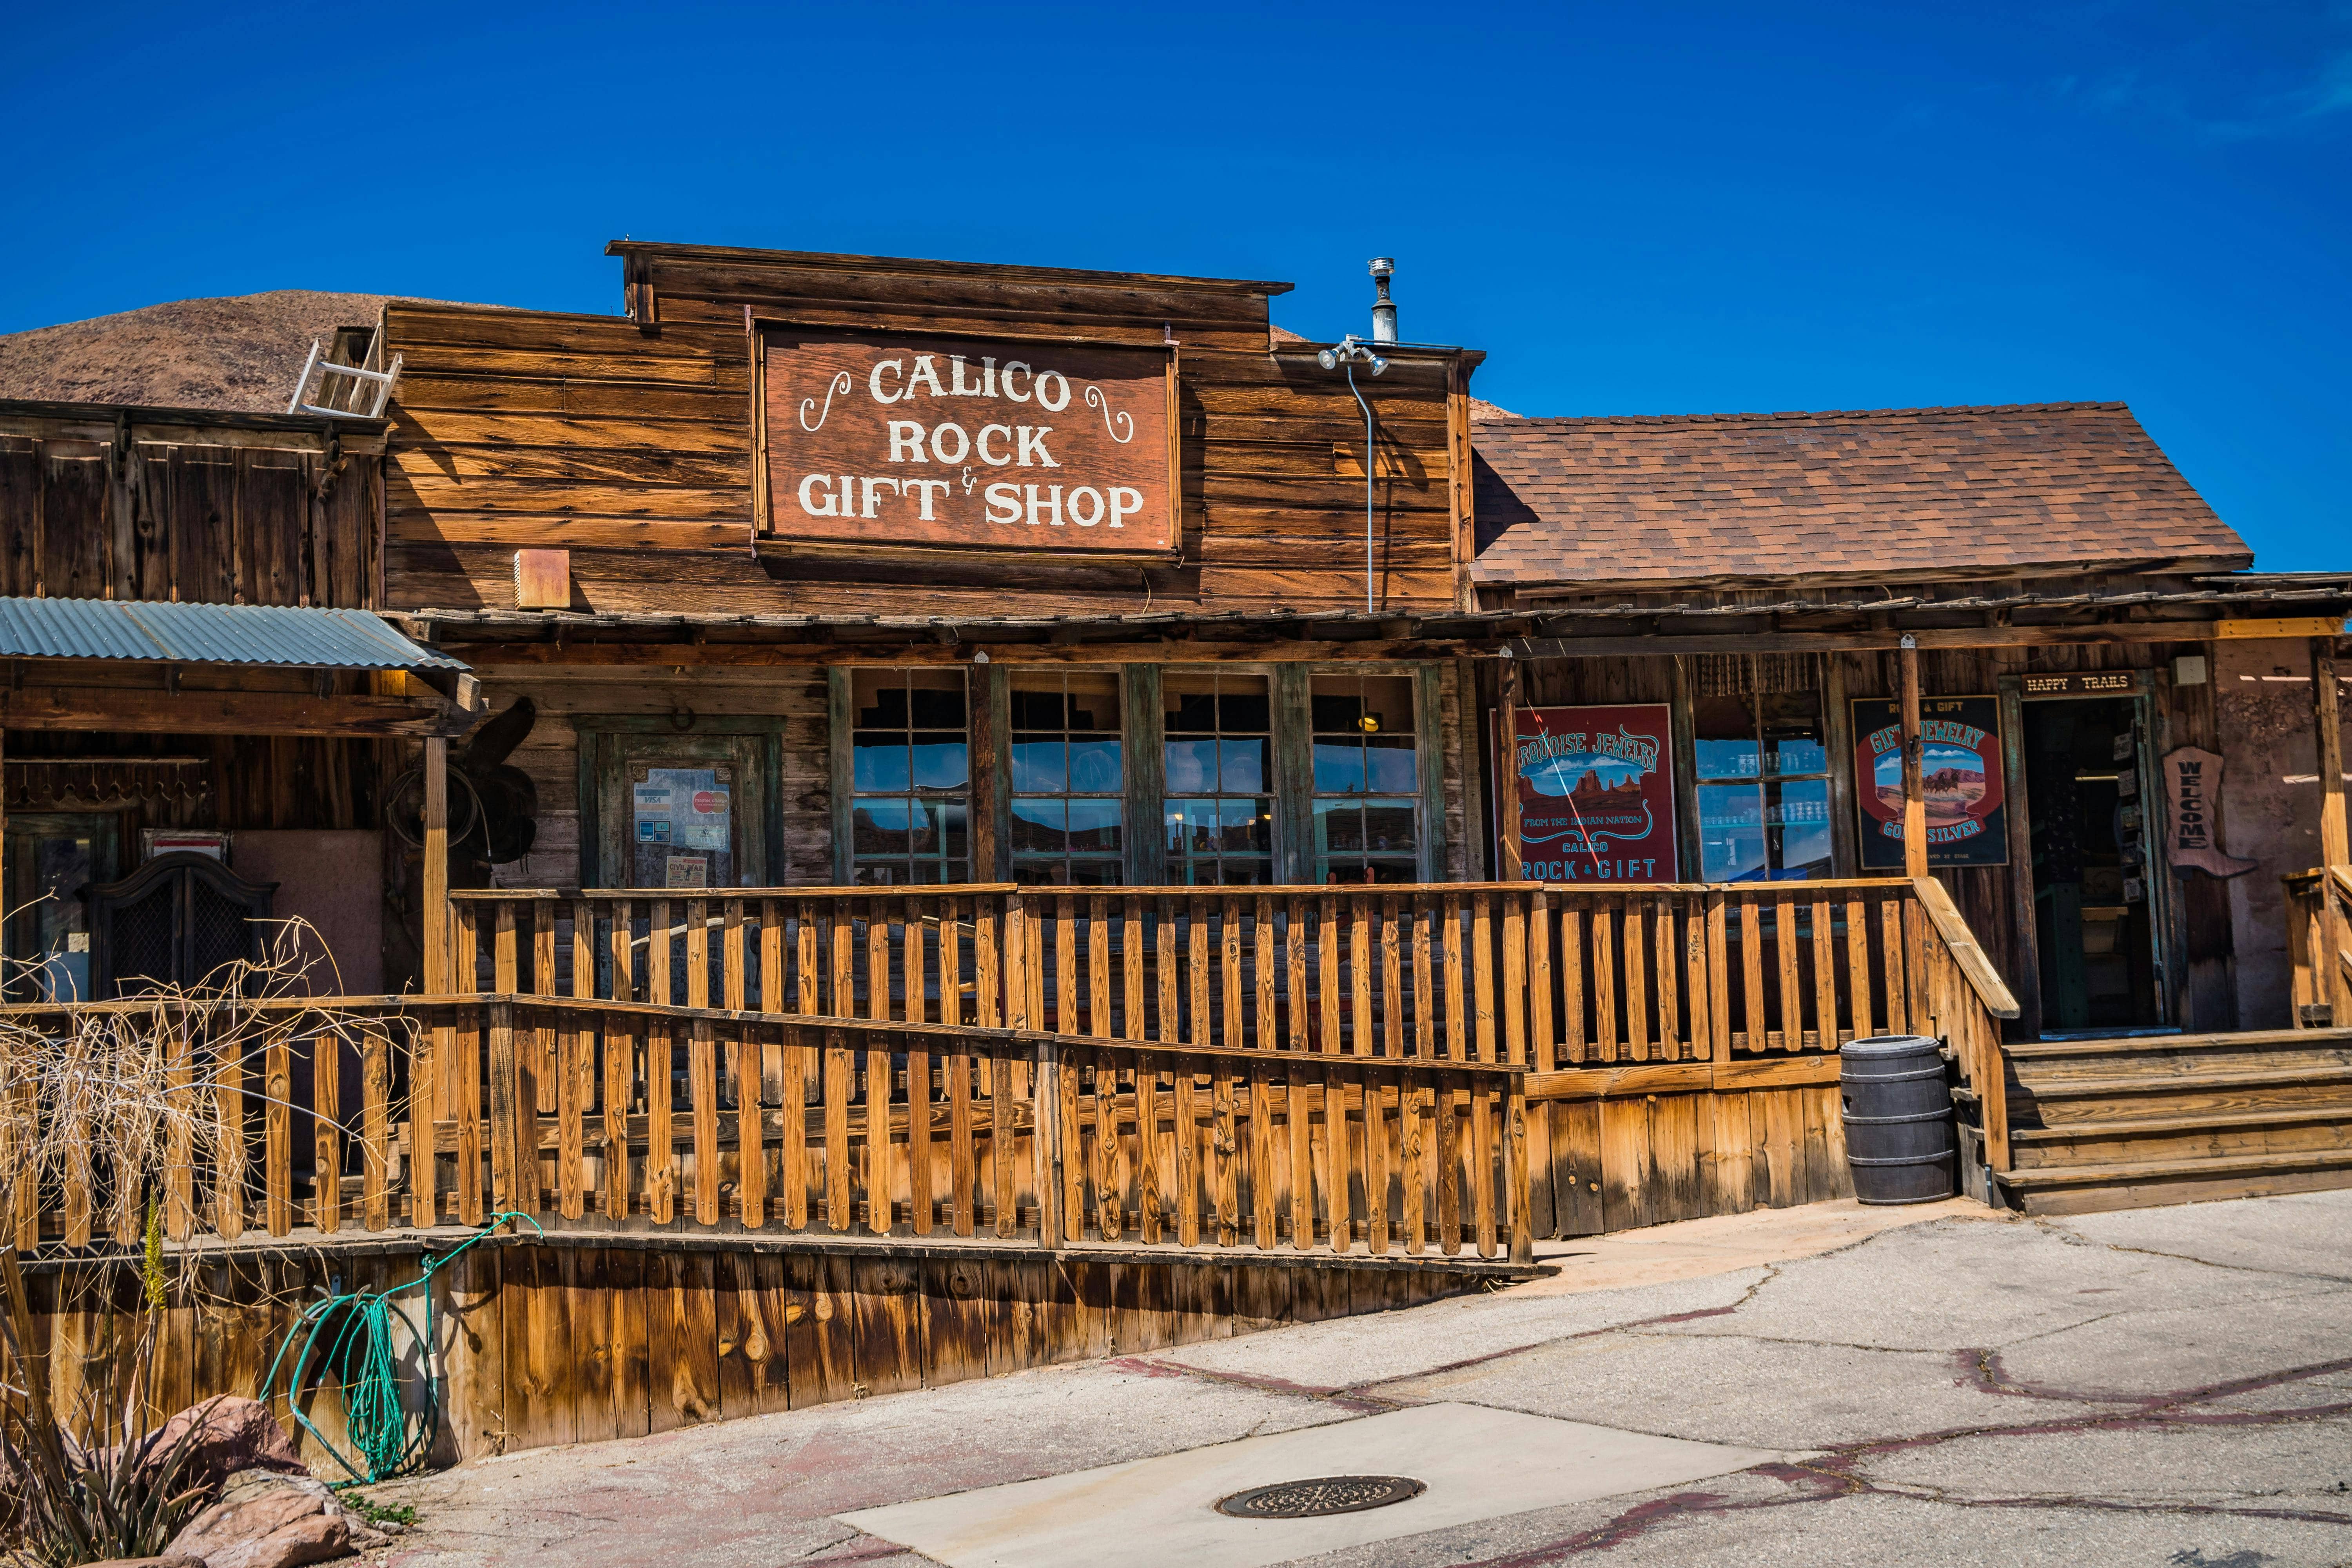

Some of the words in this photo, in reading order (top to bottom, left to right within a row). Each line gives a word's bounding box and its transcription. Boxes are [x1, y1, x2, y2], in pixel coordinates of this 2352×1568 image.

[868, 354, 1071, 412] CALICO
[887, 420, 1062, 468] ROCK
[962, 466, 977, 495] &
[798, 474, 950, 521] GIFT
[984, 483, 1143, 528] SHOP
[2027, 678, 2068, 691] HAPPY
[2082, 676, 2128, 689] TRAILS
[1924, 703, 1932, 712] &
[1937, 702, 1963, 712] GIFT
[1919, 720, 1985, 750] JEWELRY
[1517, 733, 1586, 767] RQUOISE
[1593, 733, 1658, 773] JEWELRY
[2178, 761, 2208, 850] WELCOME
[1524, 818, 1548, 827] FROM
[1571, 816, 1603, 825] INDIAN
[1606, 815, 1642, 824] NATION
[1928, 820, 1980, 842] SILVER
[1563, 842, 1608, 853] CALICO
[1521, 861, 1577, 880] ROCK
[1584, 865, 1592, 874] &
[1598, 859, 1655, 878] GIFT
